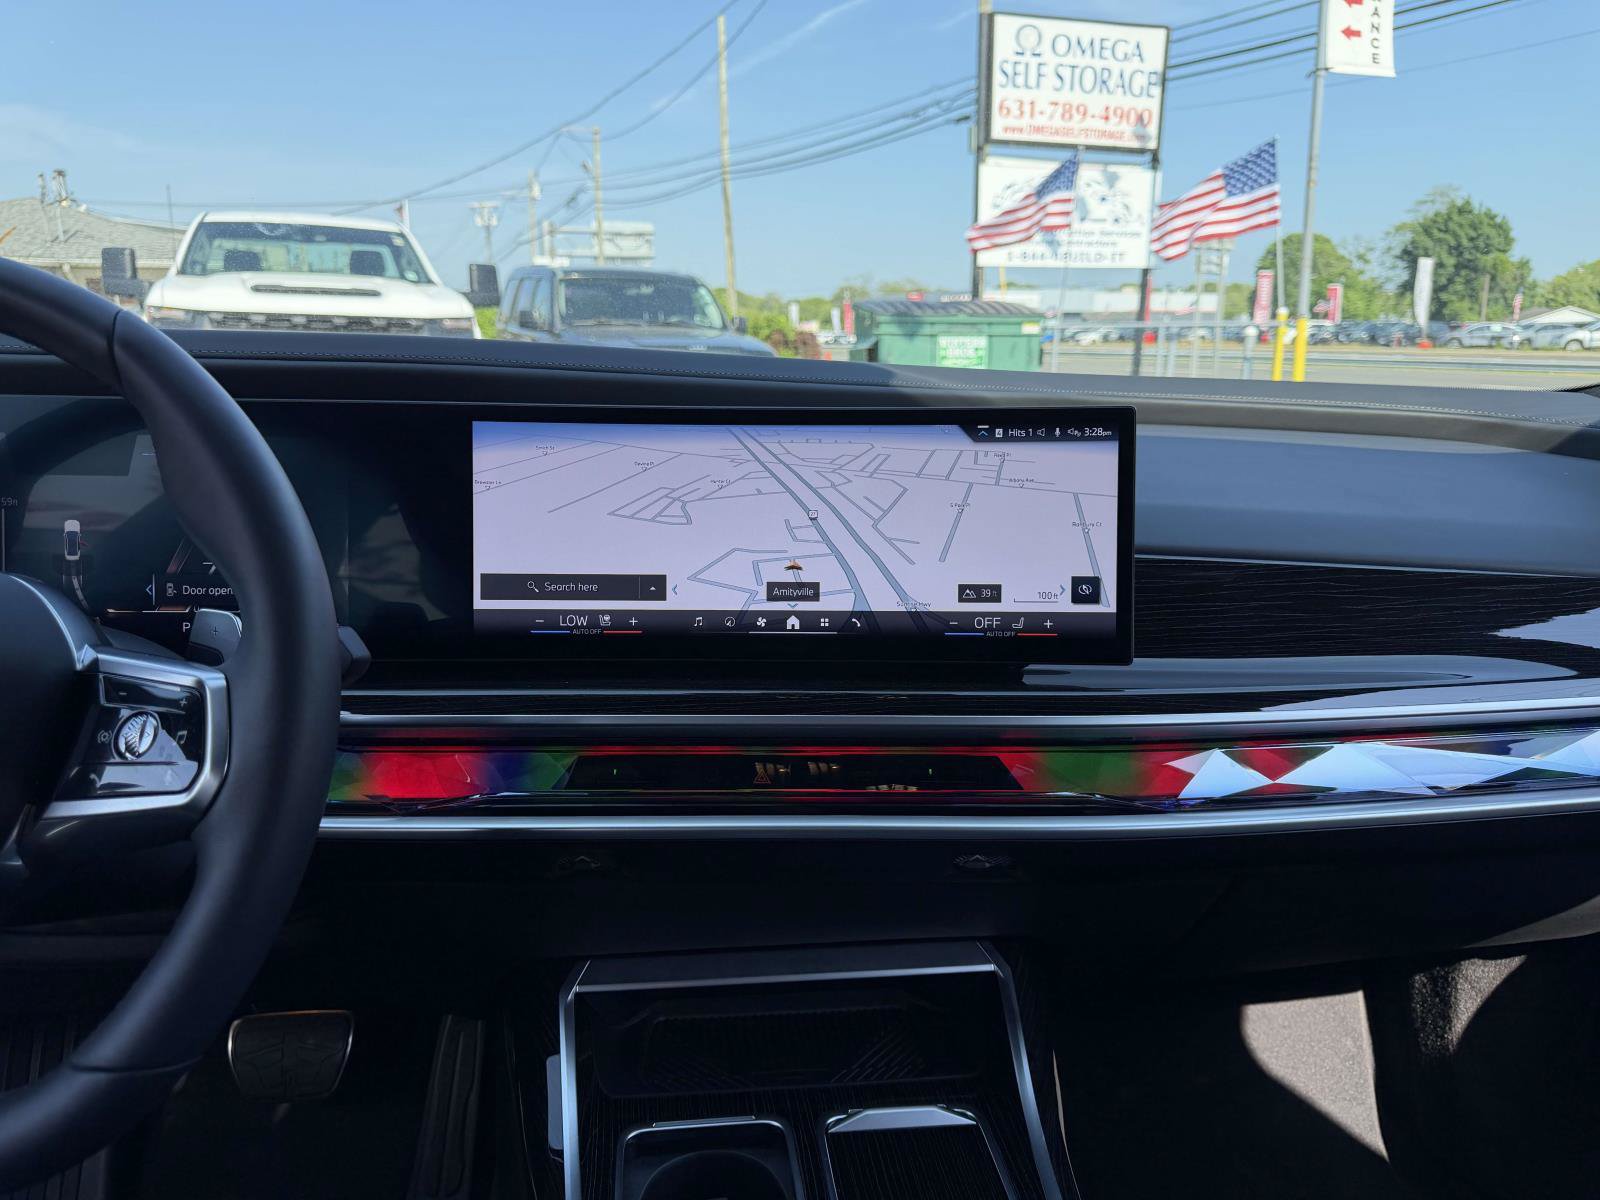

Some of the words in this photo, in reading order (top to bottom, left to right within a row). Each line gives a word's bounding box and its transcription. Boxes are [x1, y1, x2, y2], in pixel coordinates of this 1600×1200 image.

[1371, 0, 1381, 64] ANCE
[1052, 34, 1144, 63] OMEGA
[999, 60, 1048, 90] SELF
[1053, 63, 1160, 98] STORAGE
[998, 99, 1153, 128] 631-789-4900
[1008, 428, 1026, 437] Hits
[1028, 428, 1033, 437] 1
[1084, 427, 1112, 437] 3:28pm
[182, 585, 206, 595] Door
[208, 587, 233, 596] open
[544, 581, 575, 592] Search
[578, 582, 599, 592] here
[773, 587, 814, 598] Amityville
[981, 589, 991, 598] 39
[1037, 591, 1052, 600] 100
[559, 615, 588, 626] LOW
[974, 617, 1001, 629] OFF
[182, 622, 191, 633] P
